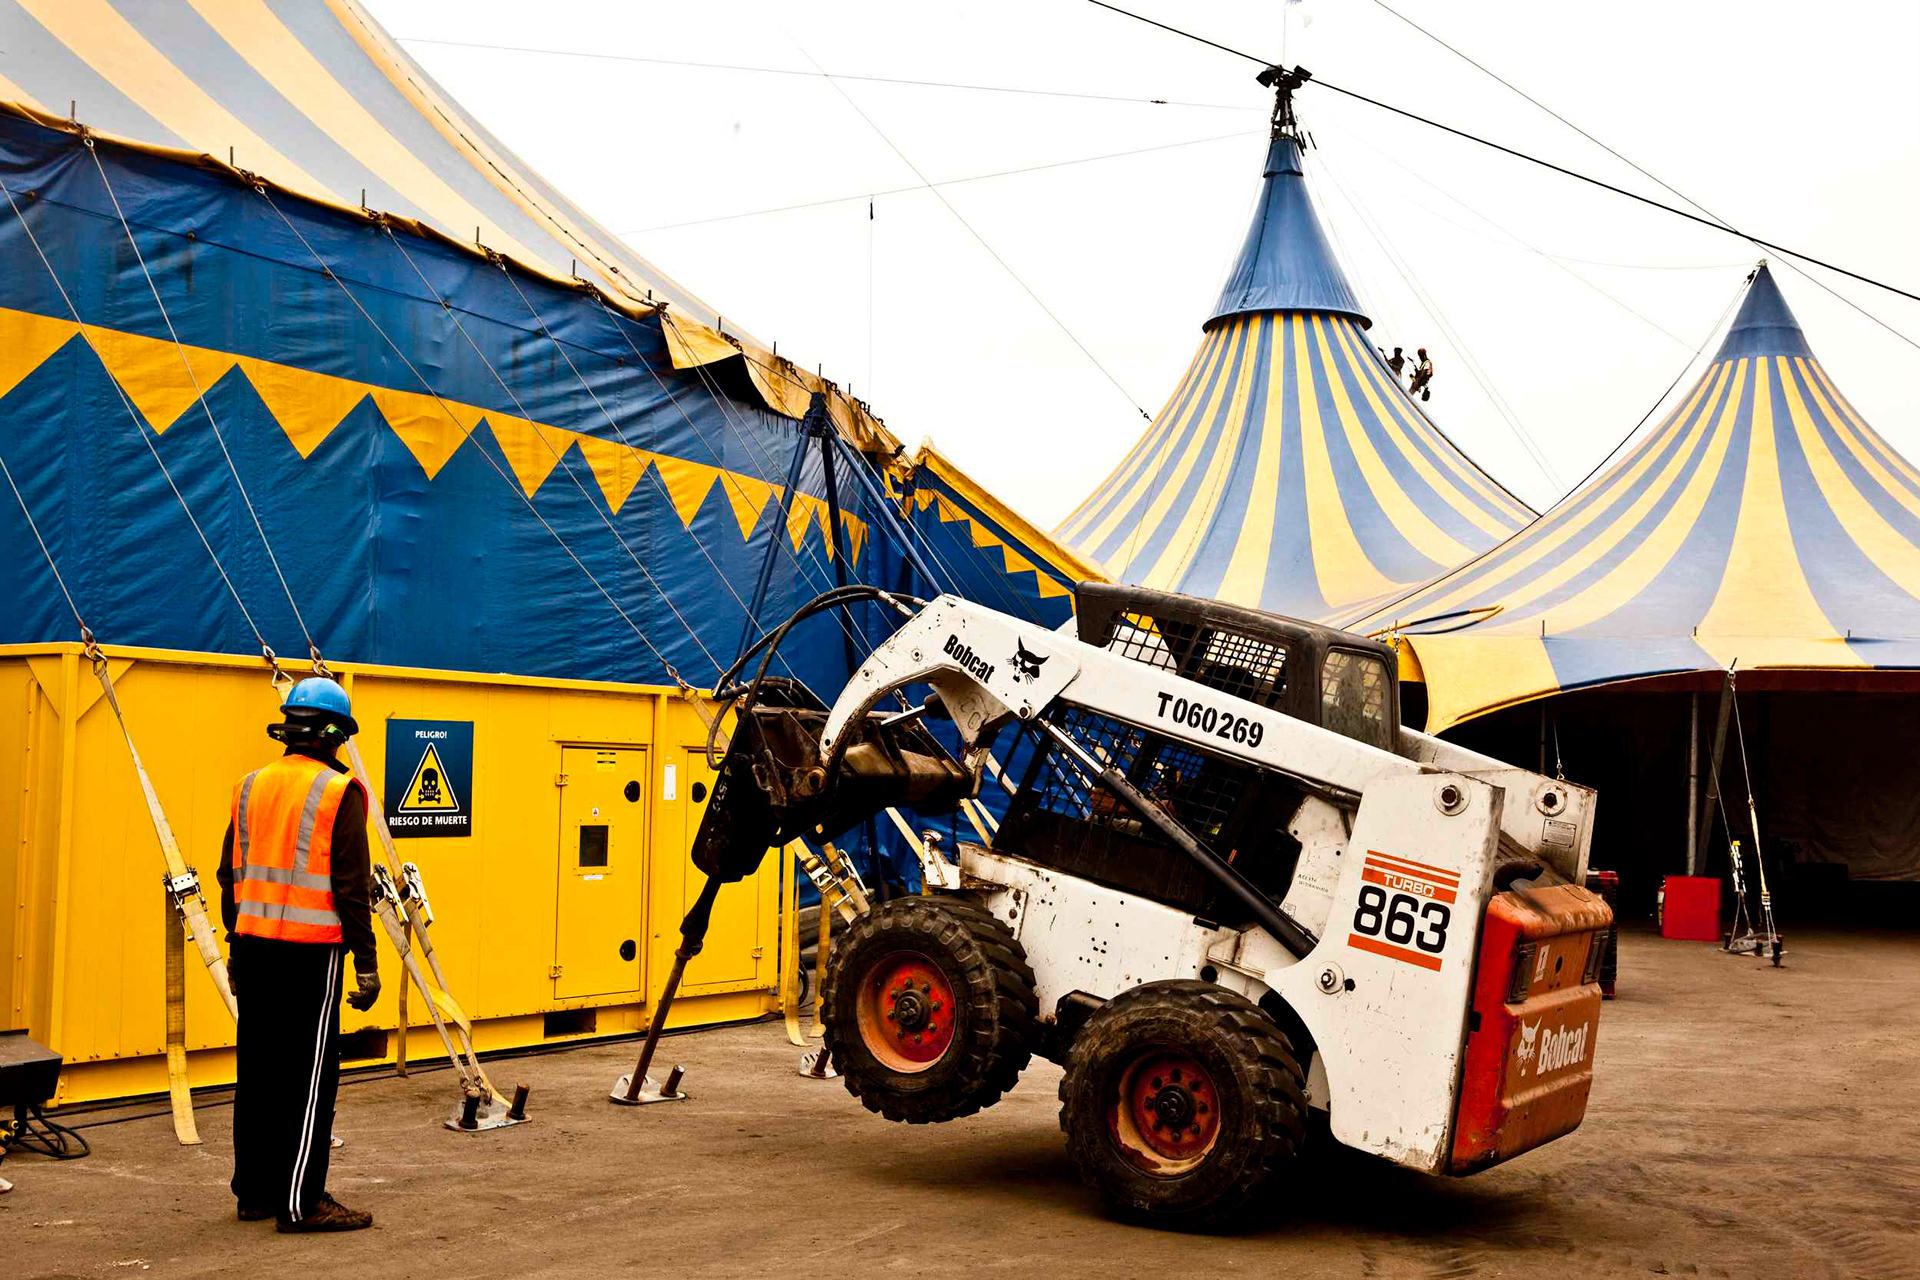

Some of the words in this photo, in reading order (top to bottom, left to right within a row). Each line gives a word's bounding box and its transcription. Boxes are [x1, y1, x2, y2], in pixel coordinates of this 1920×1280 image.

[943, 634, 995, 684] Bobcat
[415, 731, 447, 739] PELIGRO!
[1158, 691, 1263, 748] T060269
[389, 816, 419, 826] RIESGO
[422, 816, 433, 825] DE
[435, 815, 467, 825] MUERTE
[1384, 873, 1436, 897] TURBO
[1353, 885, 1451, 954] 863
[1536, 1021, 1589, 1075] Bobcat
